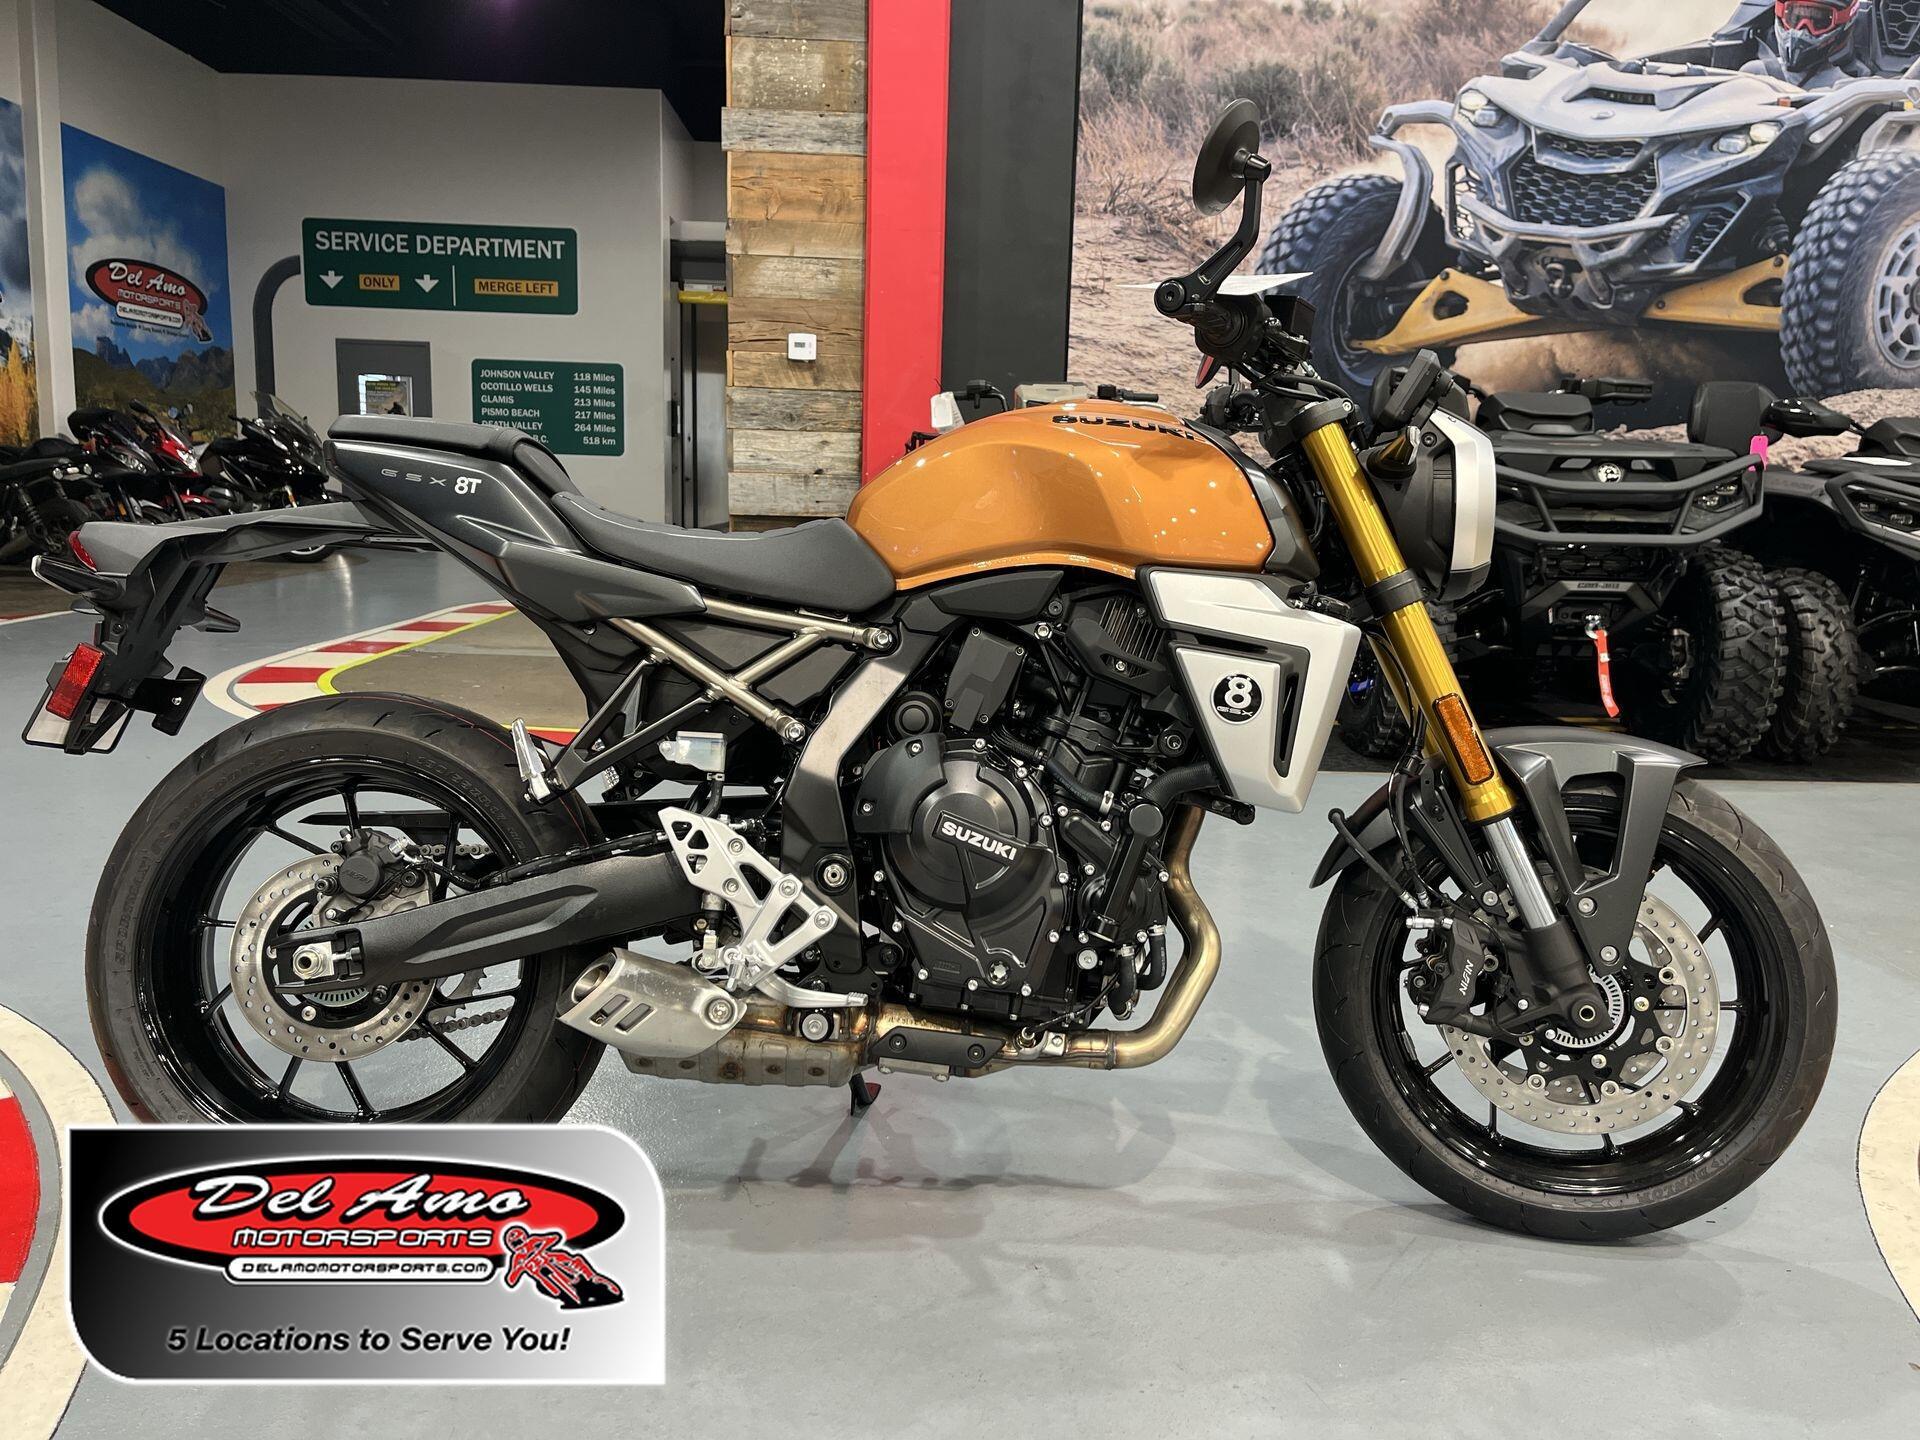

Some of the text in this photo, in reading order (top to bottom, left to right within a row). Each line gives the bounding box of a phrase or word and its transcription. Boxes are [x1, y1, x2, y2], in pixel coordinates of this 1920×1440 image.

[315, 231, 565, 259] SERVICE DEPARTMENT
[109, 261, 186, 296] Del Amo
[363, 275, 395, 289] ONLY
[478, 279, 554, 295] MERGE LEFT
[117, 288, 181, 310] MOTORSPORTS
[480, 369, 615, 382] JOHNSON VALLEY 118 Miles
[480, 382, 616, 395] OCOTILLO WELLS 145 Miles
[480, 395, 616, 407] GLAMIS 213 Miles
[481, 407, 616, 420] PISMO BEACH 217 Miles
[511, 421, 543, 430] VALLEY
[574, 424, 591, 433] 264
[593, 424, 616, 433] Miles
[1052, 415, 1195, 440] SUZUKI
[582, 436, 600, 445] 518
[602, 437, 616, 446] km
[381, 468, 482, 495] GSX 8T
[1224, 676, 1253, 709] 8
[1216, 705, 1254, 717] GSX
[941, 821, 1018, 861] SUZUKI
[1459, 959, 1474, 996] NISSIN
